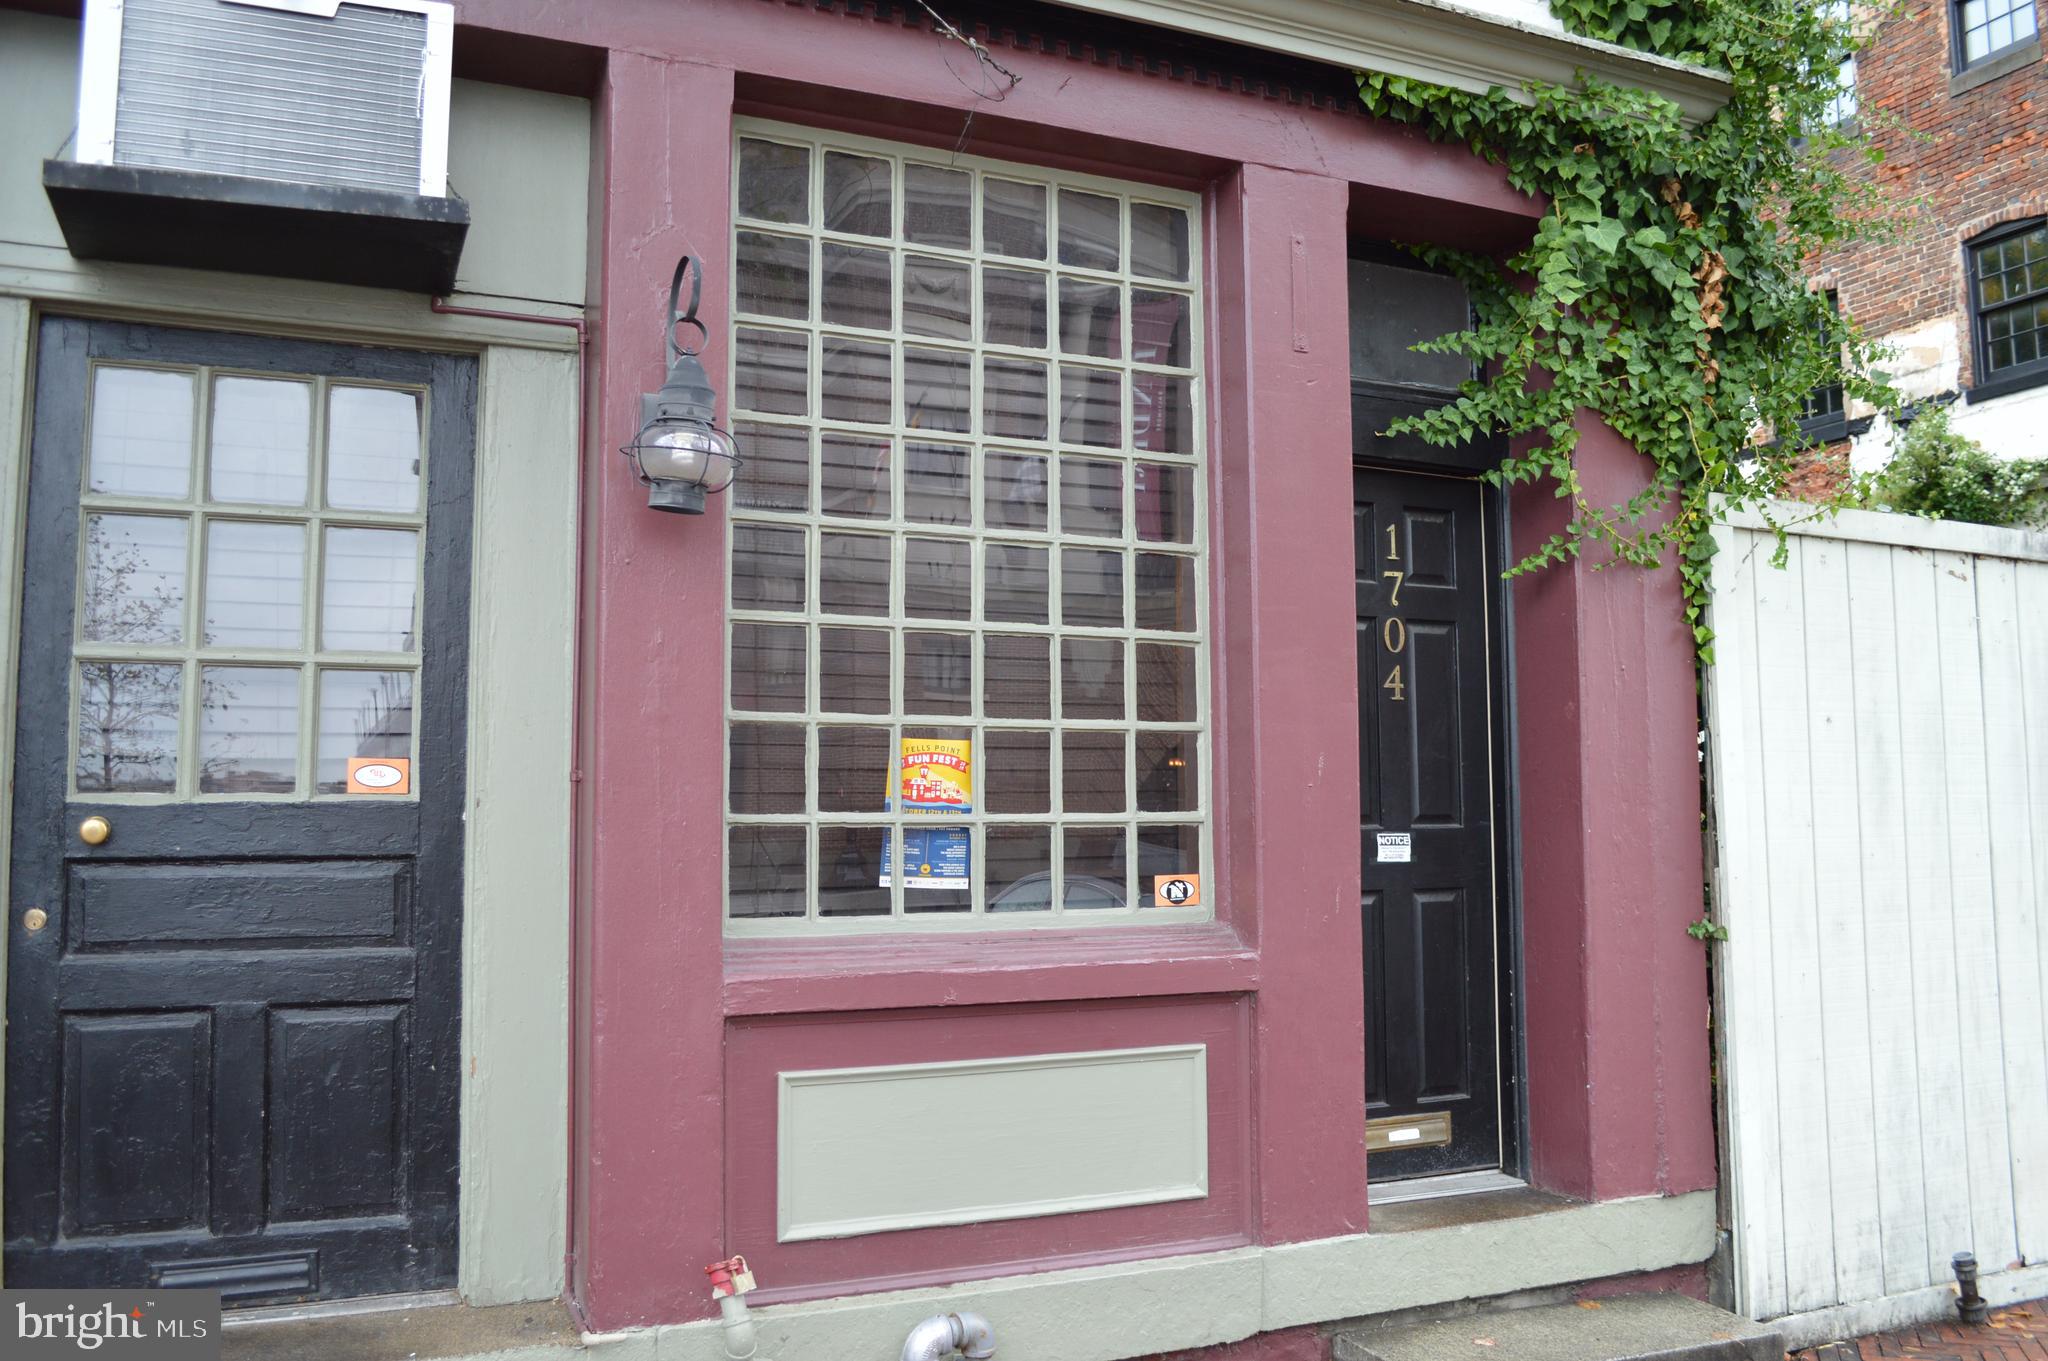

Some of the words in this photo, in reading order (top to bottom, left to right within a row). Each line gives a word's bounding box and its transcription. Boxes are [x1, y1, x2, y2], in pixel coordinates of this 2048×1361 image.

[1383, 523, 1406, 701] 1704
[905, 745, 931, 753] FELLS
[934, 745, 961, 754] POINT
[908, 754, 930, 764] FUN
[932, 754, 958, 765] FEST
[1378, 836, 1410, 845] NOTICE
